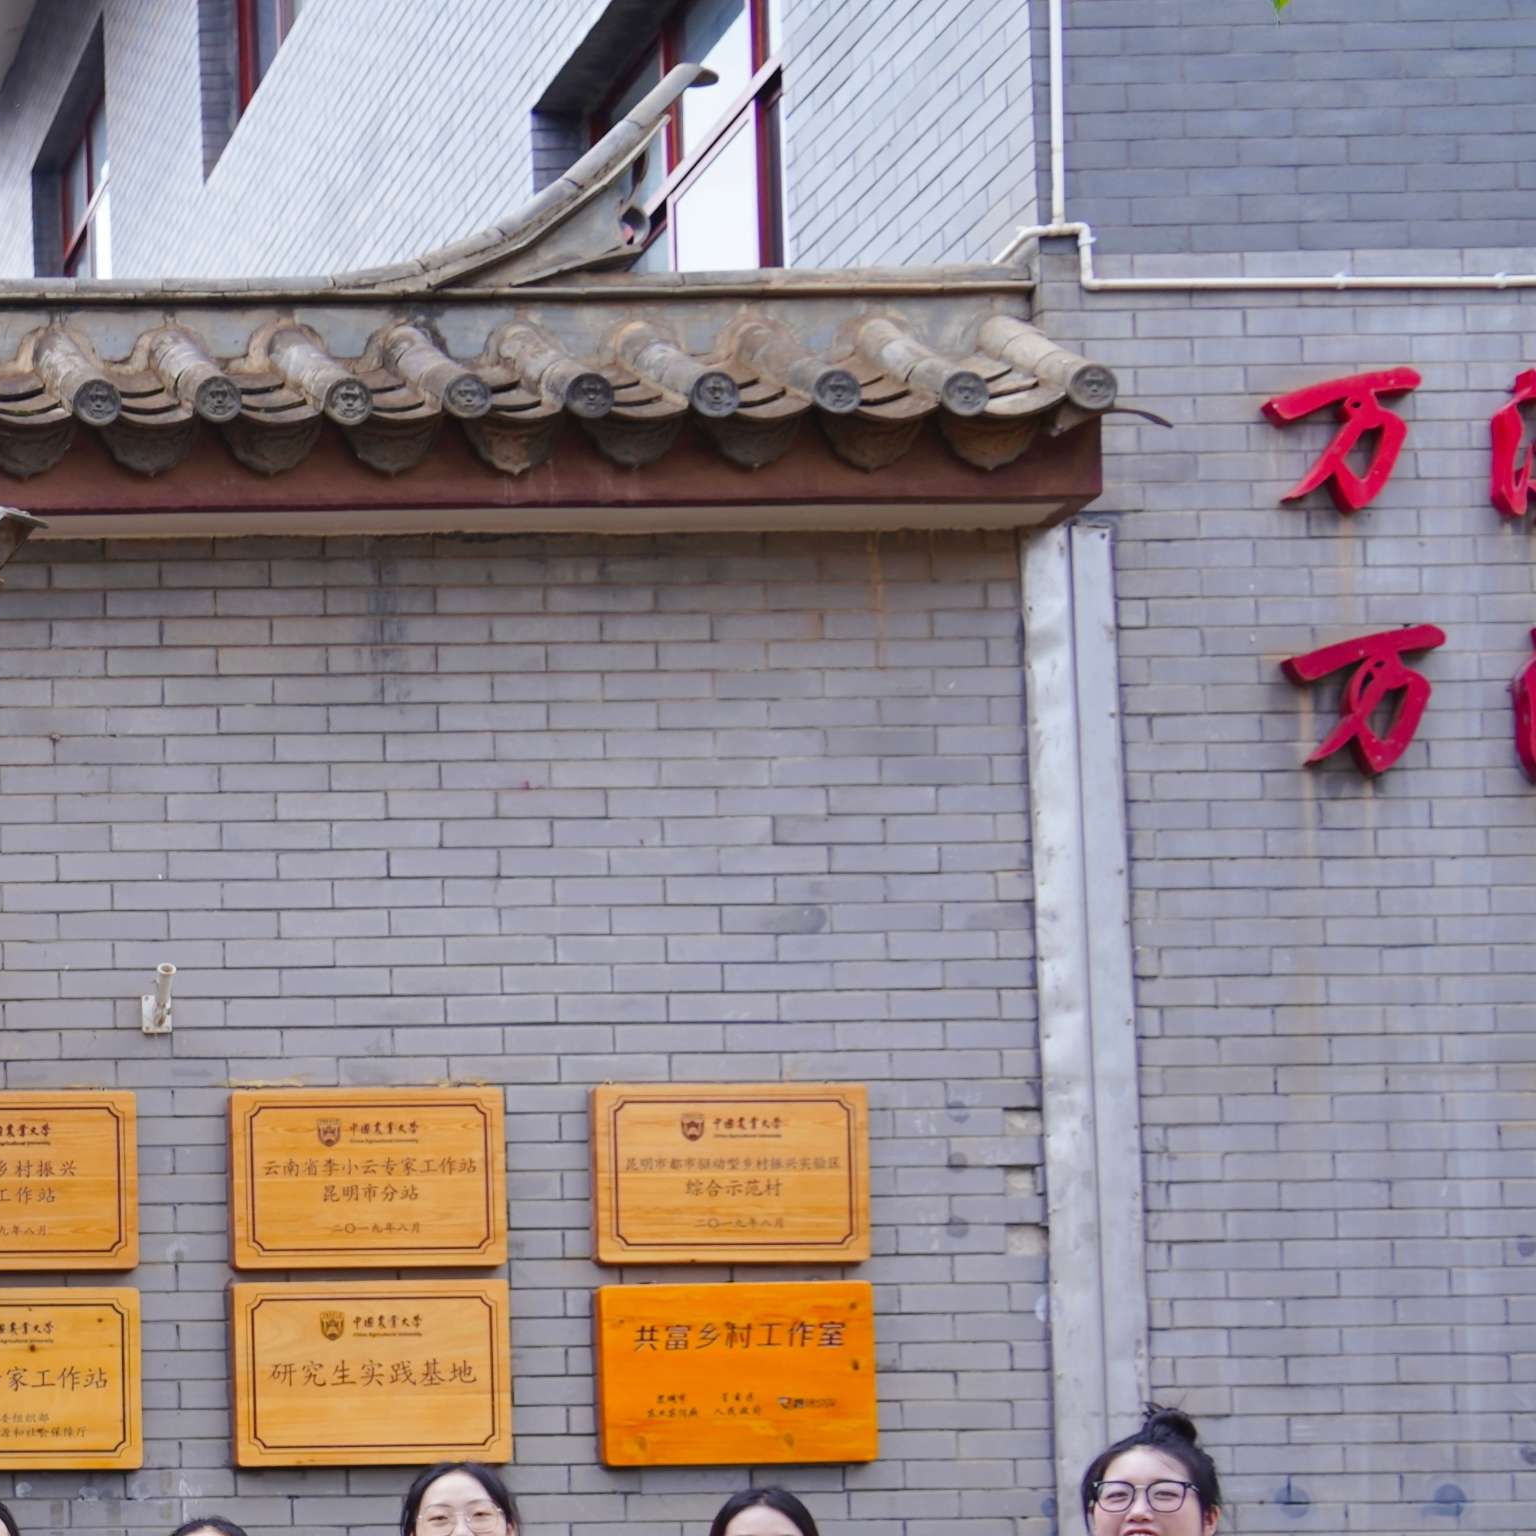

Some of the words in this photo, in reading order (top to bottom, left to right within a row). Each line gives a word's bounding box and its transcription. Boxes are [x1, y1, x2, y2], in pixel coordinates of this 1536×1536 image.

[263, 1157, 477, 1177] 云南省李小云专家工作站
[322, 1183, 419, 1203] 昆明市分站
[684, 1178, 784, 1198] 综合示范村
[633, 1321, 847, 1352] 共富乡村工作室
[271, 1357, 479, 1388] 研究生实践基地
